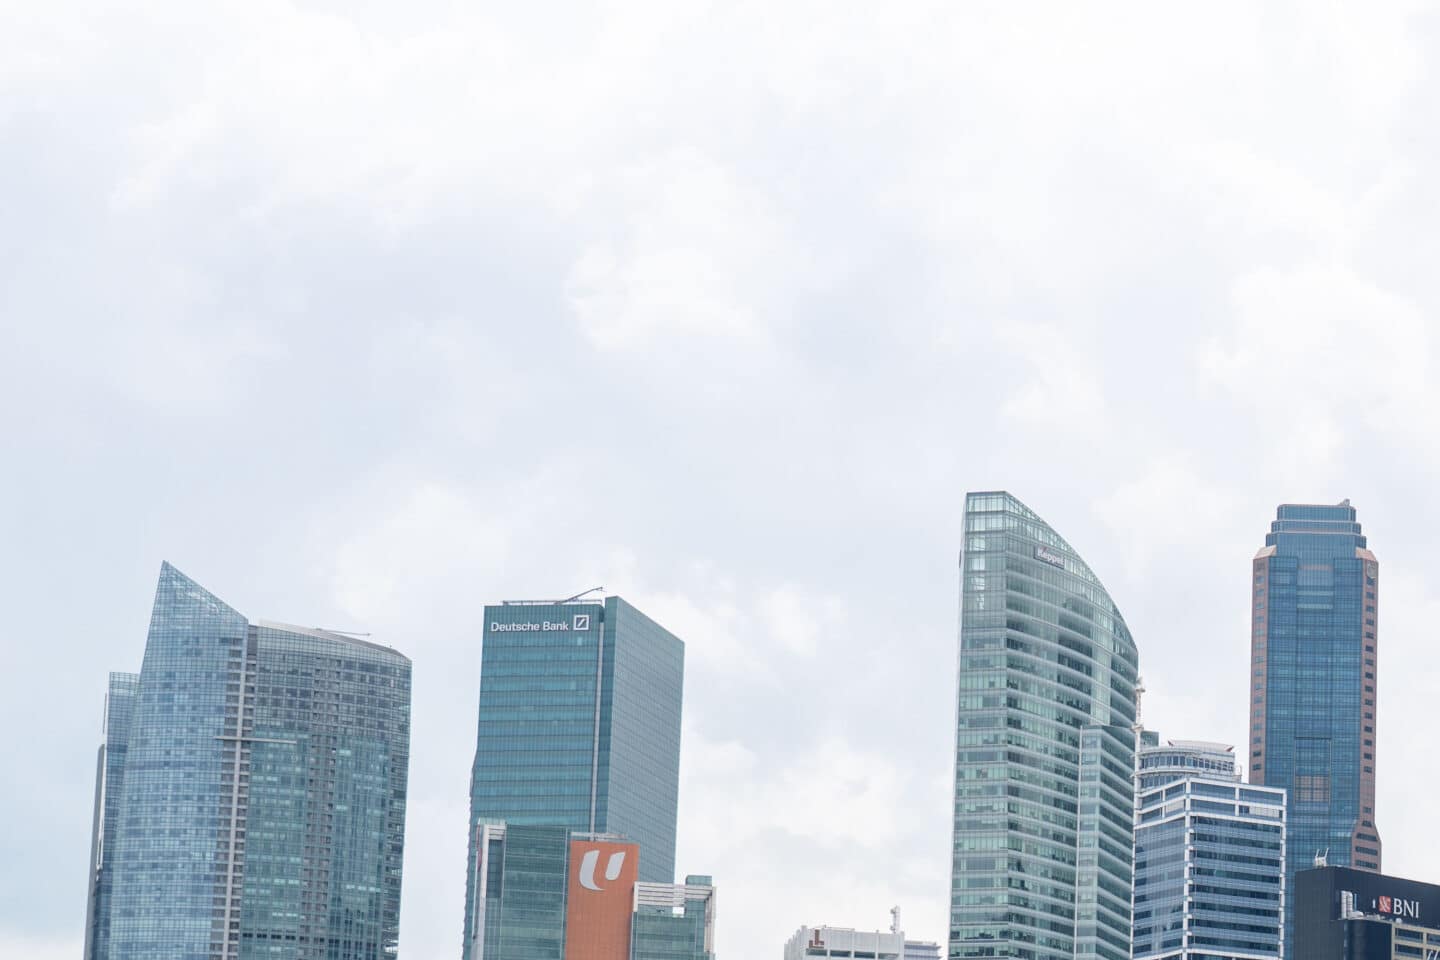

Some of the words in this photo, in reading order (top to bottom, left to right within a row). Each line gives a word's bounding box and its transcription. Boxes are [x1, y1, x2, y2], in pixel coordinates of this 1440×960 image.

[1038, 548, 1064, 566] Keppel
[491, 622, 540, 632] Deutsche
[543, 621, 569, 631] Bank
[1393, 899, 1419, 919] BNI
